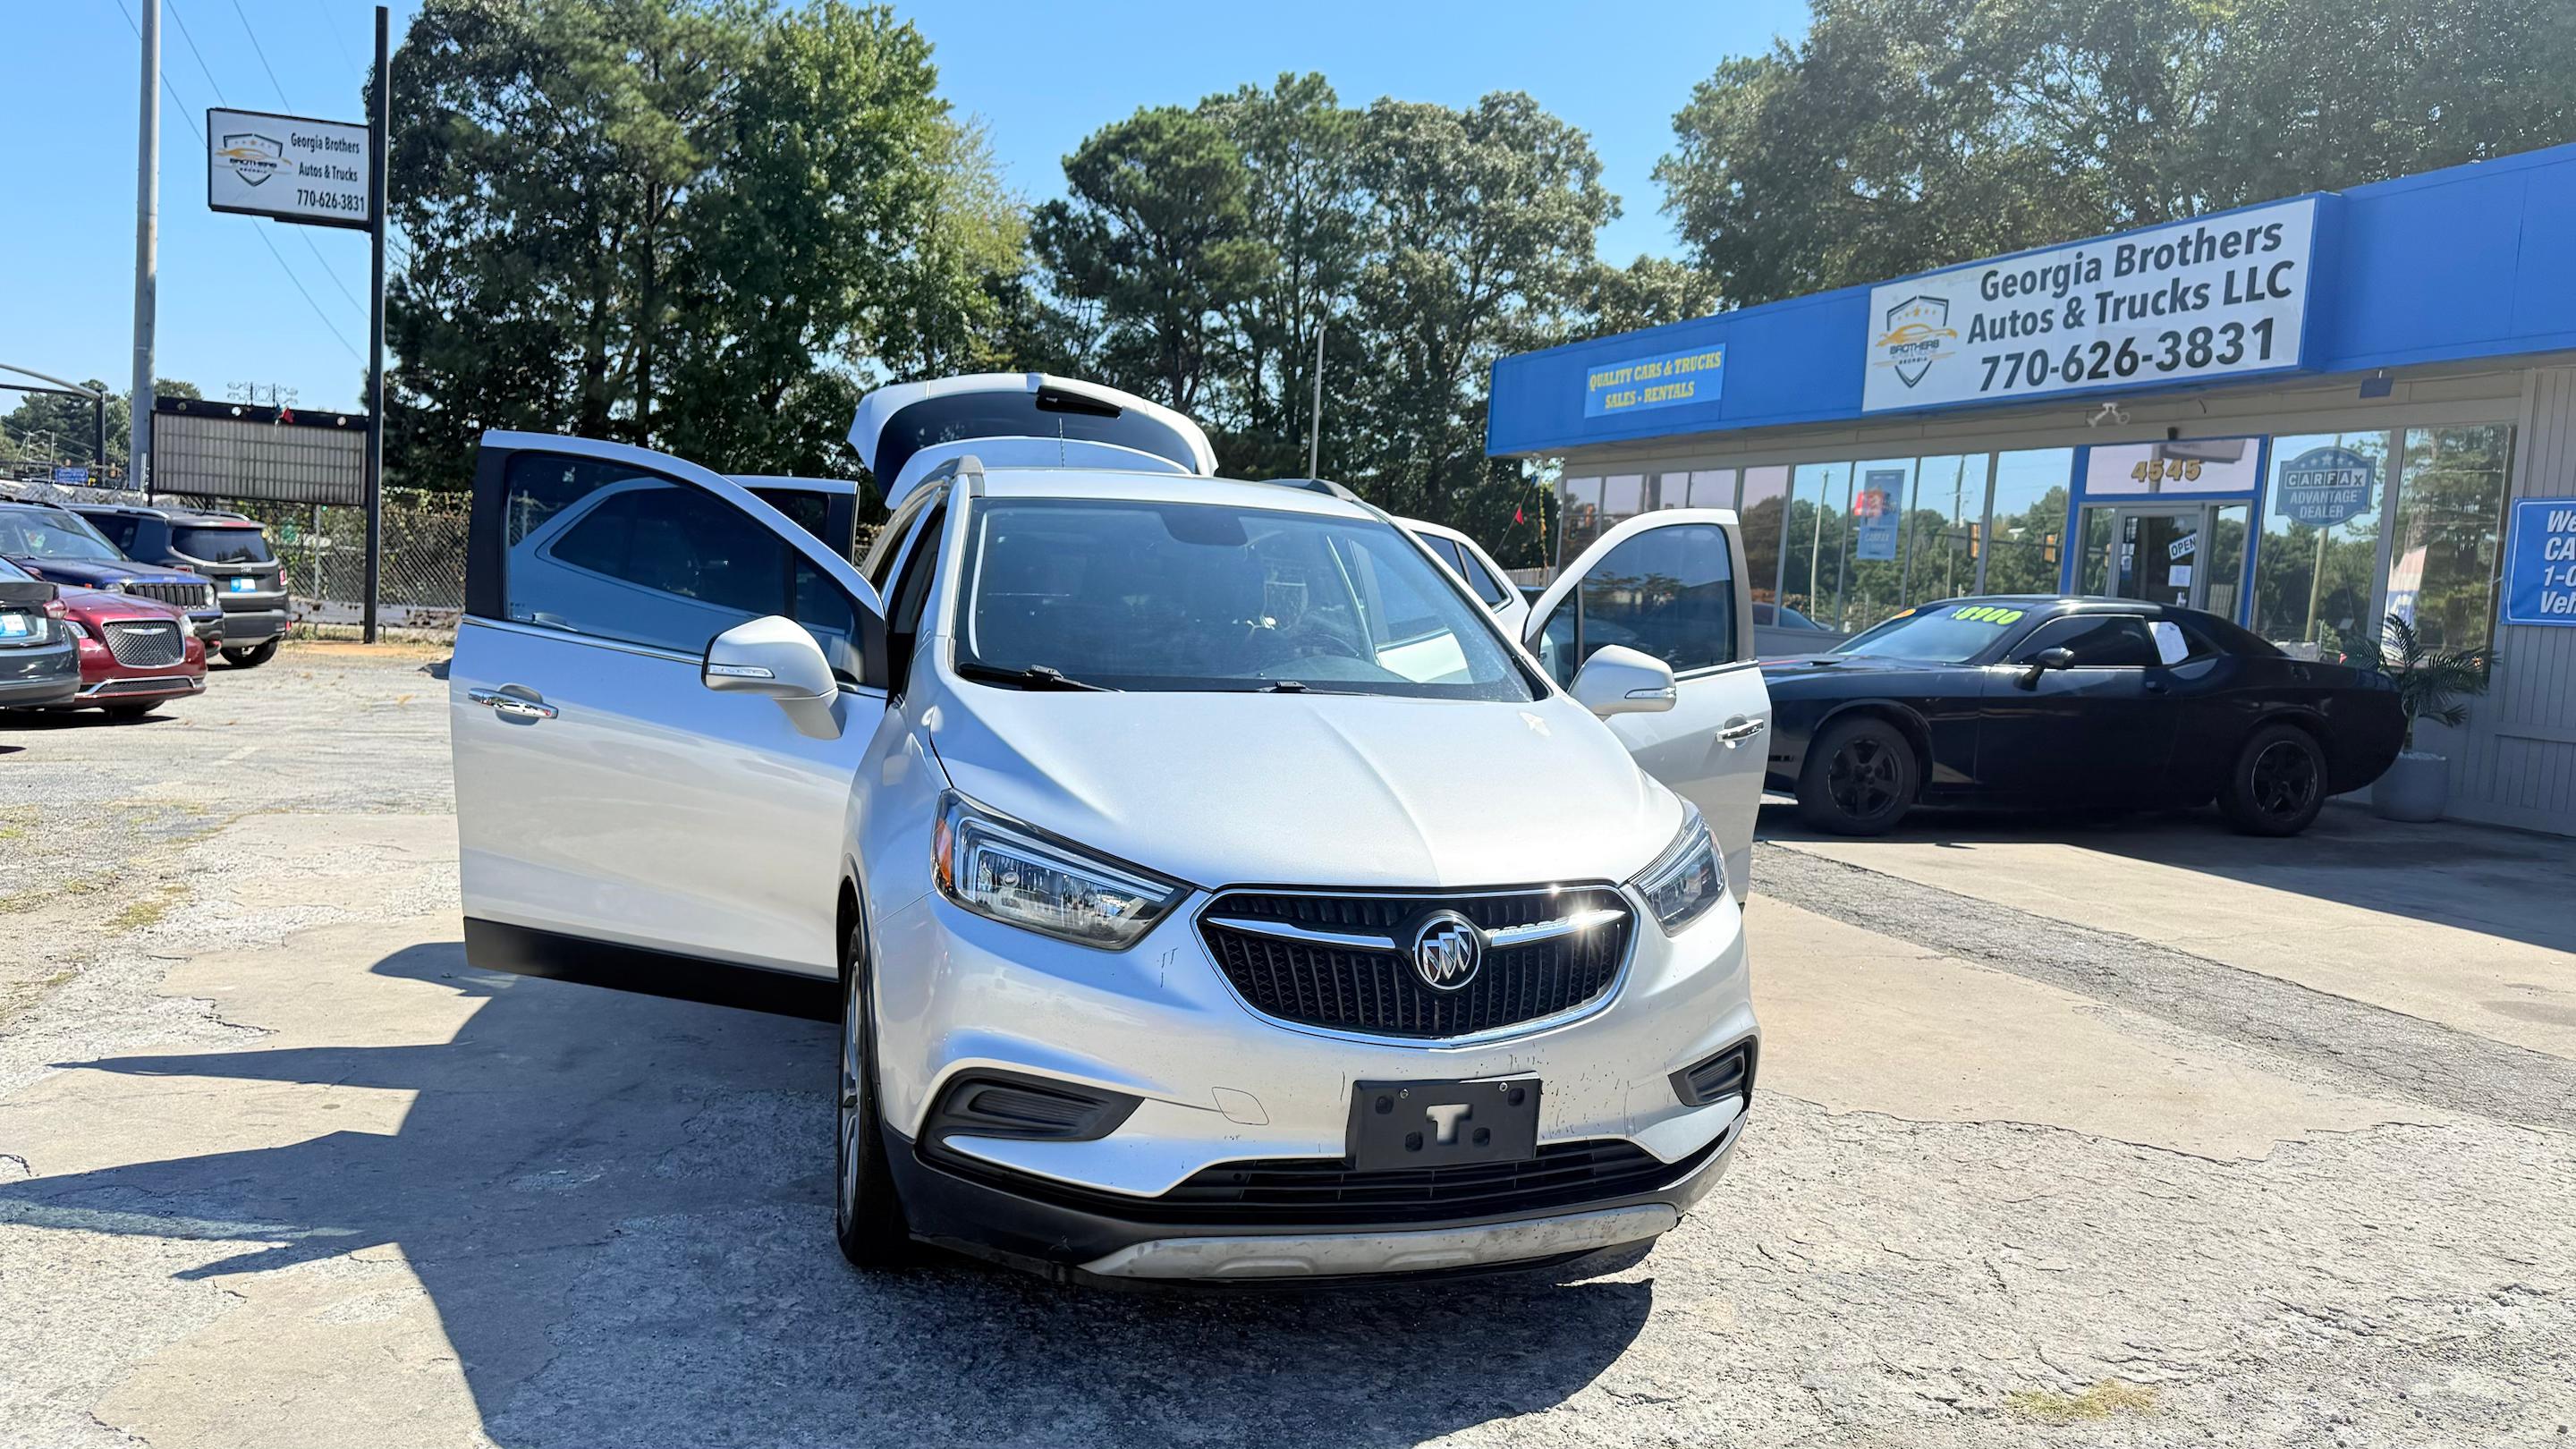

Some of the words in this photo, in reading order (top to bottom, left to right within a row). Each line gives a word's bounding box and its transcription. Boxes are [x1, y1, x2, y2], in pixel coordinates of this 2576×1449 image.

[291, 132, 323, 153] Georgia
[325, 136, 360, 154] Brothers
[299, 162, 322, 177] Autos
[324, 165, 330, 178] &
[332, 166, 358, 182] Trucks
[297, 189, 365, 212] 770-626-3831
[1981, 252, 2102, 301] Georgia
[2114, 222, 2284, 277] Brothers
[1968, 308, 2054, 344] Autos
[2063, 296, 2085, 330] &
[2094, 277, 2210, 325] Trucks
[2222, 259, 2295, 306] LLC
[1889, 339, 1940, 354] BROTHERS
[1979, 317, 2275, 393] 770-626-3831
[1589, 369, 1633, 391] QUALITY
[1633, 361, 1662, 382] CARS
[1663, 360, 1673, 376] &
[1674, 352, 1722, 373] TRUCKS
[1605, 390, 1637, 410] SALES
[1644, 381, 1696, 403] RENTALS
[2131, 457, 2202, 483] 4545
[2289, 470, 2363, 487] CARFAX
[2290, 489, 2358, 504] ADVANTAGE
[2299, 504, 2344, 519] DEALER
[2546, 510, 2576, 533] We
[2171, 538, 2197, 557] OPEN
